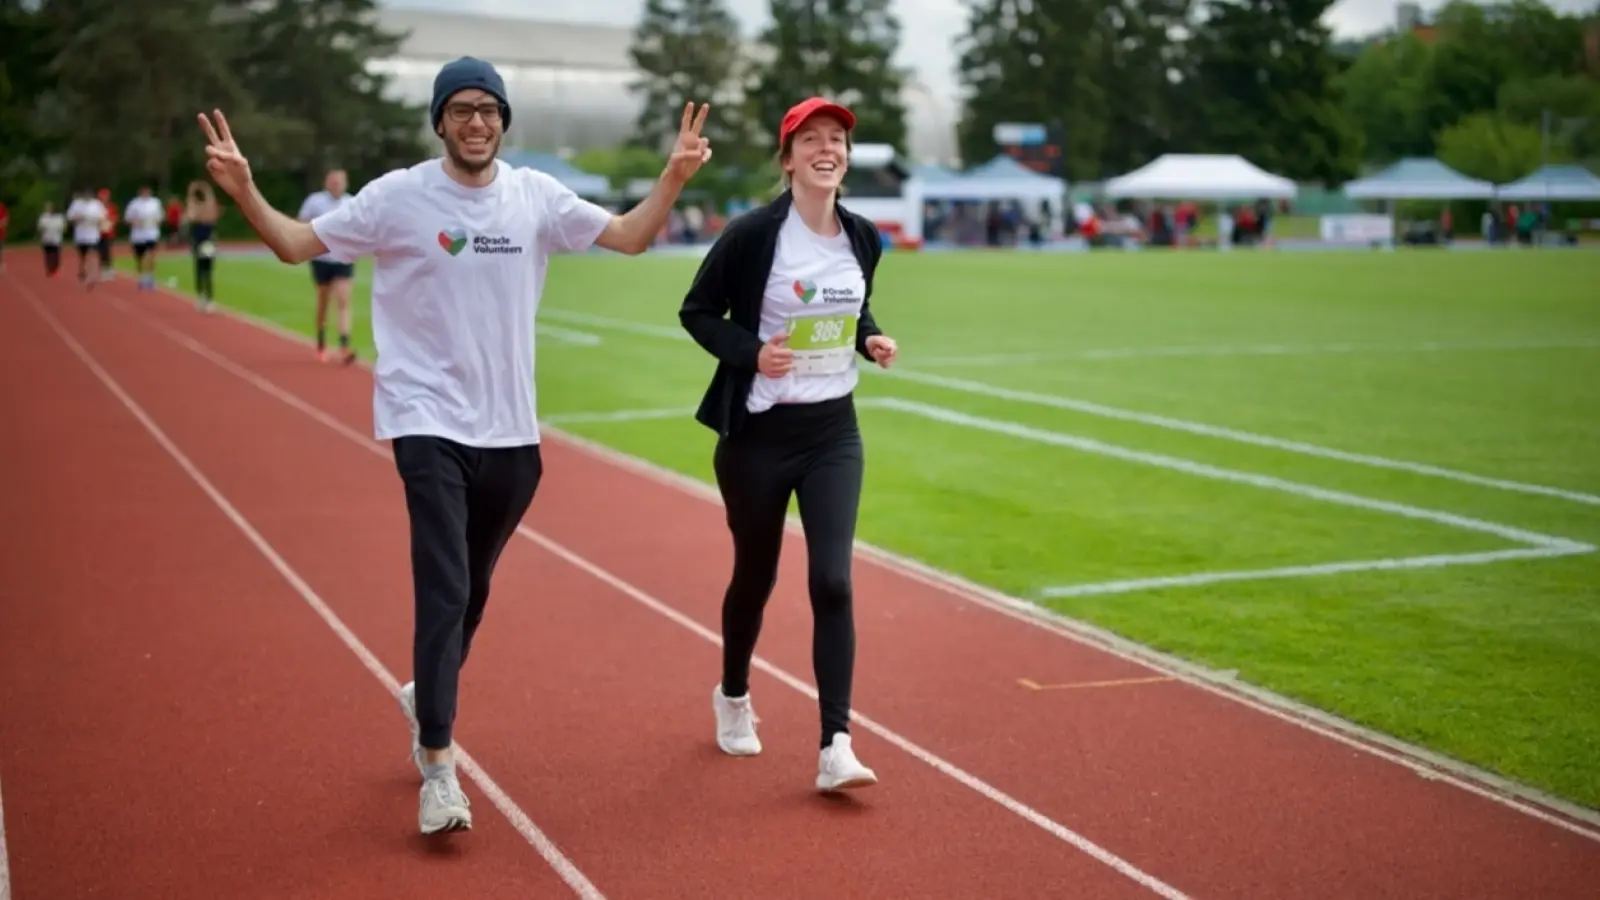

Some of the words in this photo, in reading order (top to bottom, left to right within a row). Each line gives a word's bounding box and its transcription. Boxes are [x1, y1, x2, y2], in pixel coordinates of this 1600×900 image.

[474, 236, 510, 245] #Oracle
[474, 245, 523, 254] Volunteers
[822, 287, 853, 295] #Oracle
